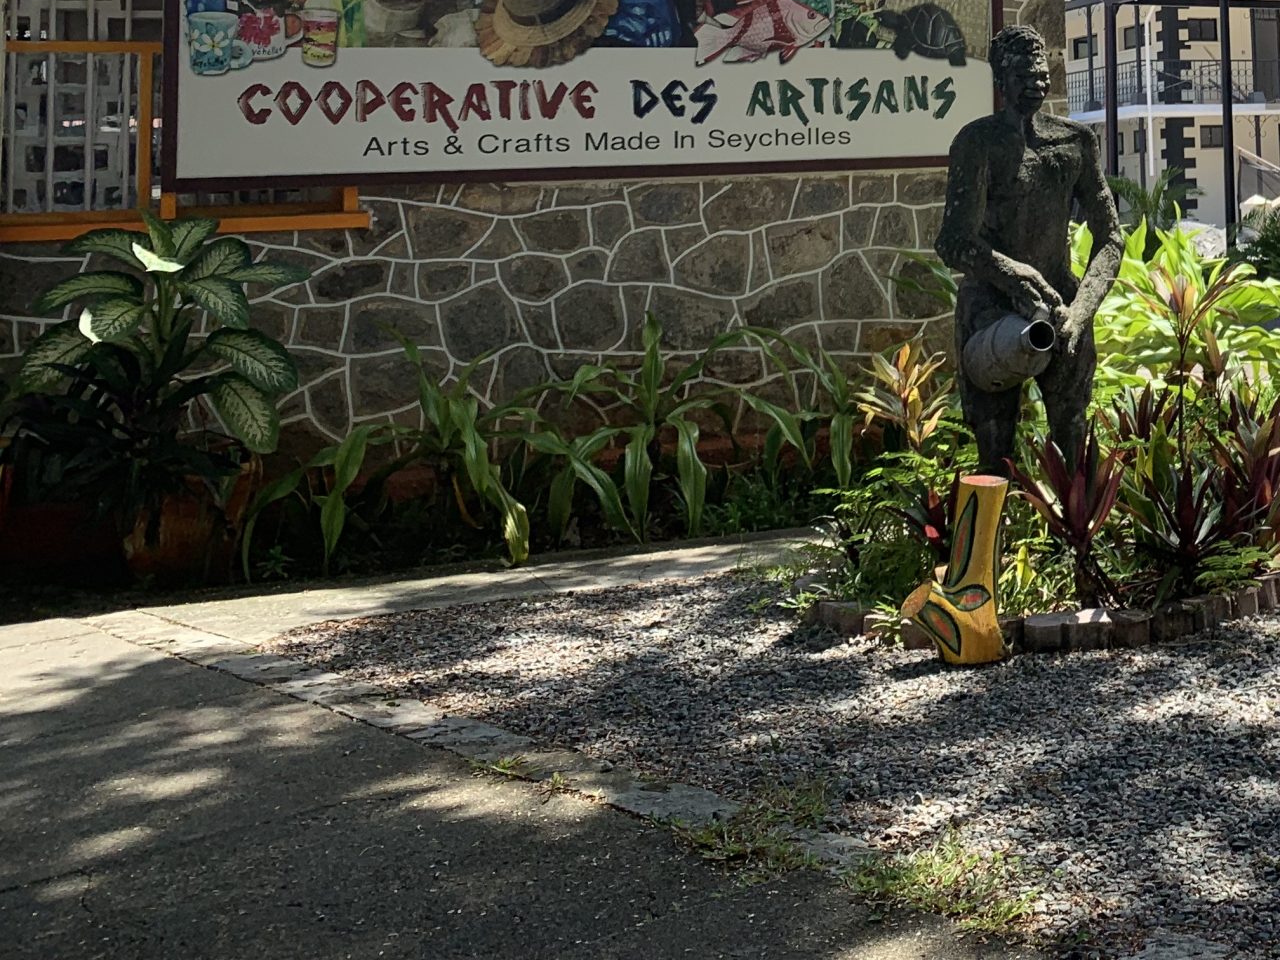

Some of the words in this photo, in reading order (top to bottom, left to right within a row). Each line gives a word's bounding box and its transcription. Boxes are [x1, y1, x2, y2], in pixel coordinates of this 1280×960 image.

[236, 79, 599, 134] COOPERATIVE
[629, 78, 718, 125] DES
[745, 75, 957, 127] ARTISANS
[362, 136, 430, 157] Arts
[443, 135, 464, 155] &
[477, 133, 571, 154] Crafts
[585, 130, 661, 152] Made
[674, 130, 695, 149] In
[708, 126, 851, 152] Seychelles
